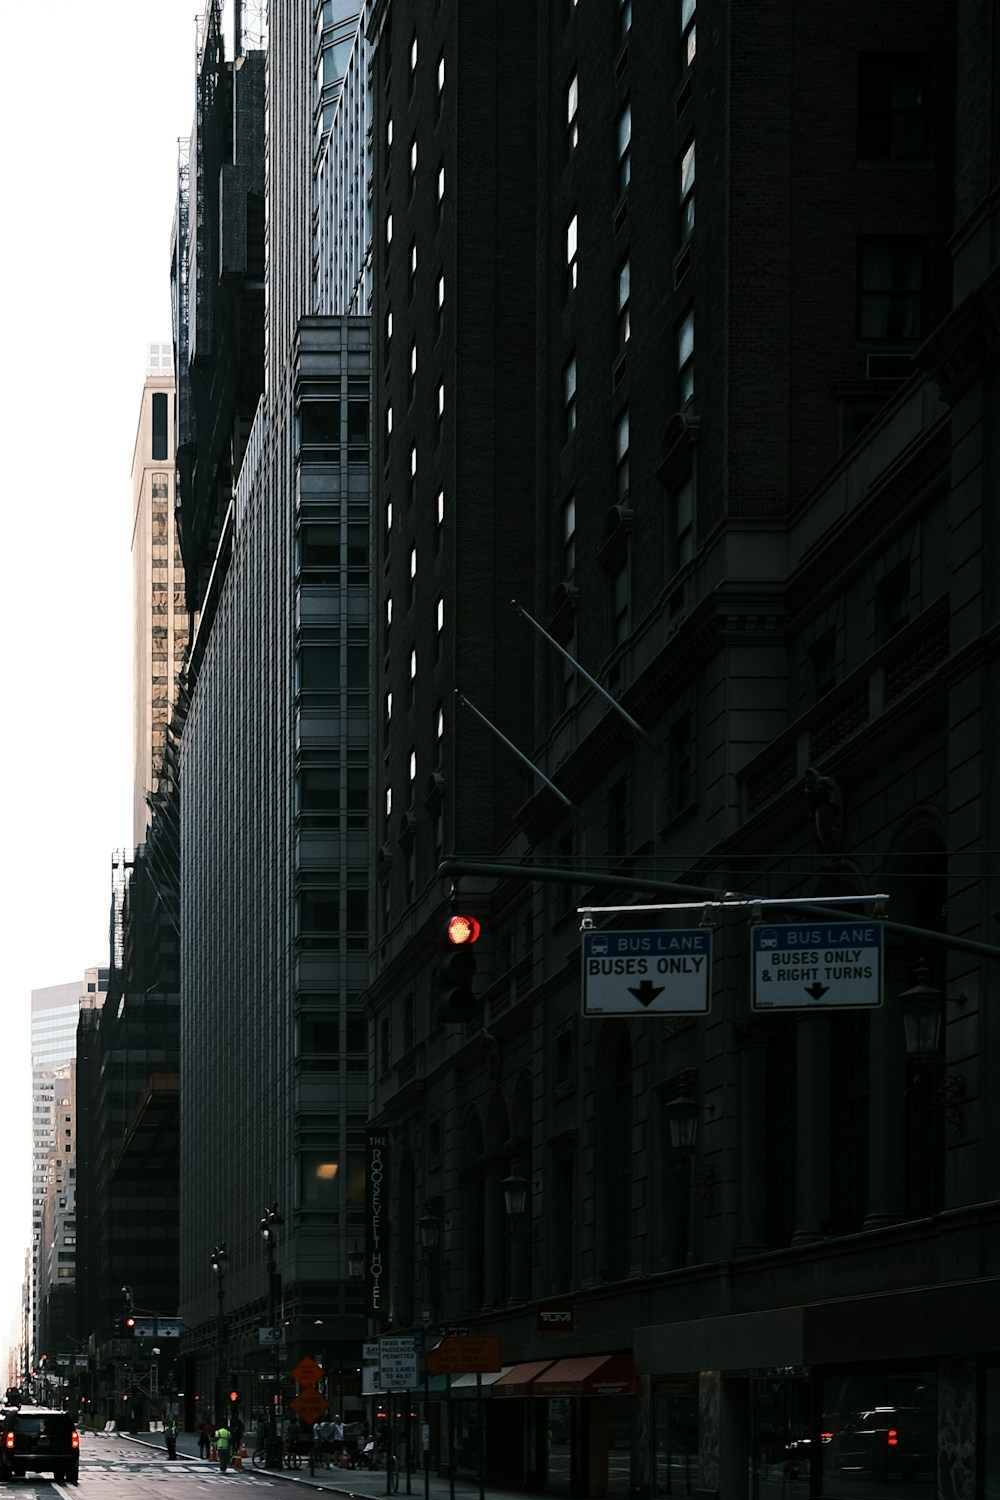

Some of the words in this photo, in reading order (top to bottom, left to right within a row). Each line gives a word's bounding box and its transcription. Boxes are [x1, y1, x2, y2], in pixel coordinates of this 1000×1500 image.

[617, 937, 651, 951] BUS
[657, 936, 704, 950] LANE
[787, 931, 821, 944] BUS
[828, 929, 875, 943] LANE
[771, 952, 819, 965] BUSES
[824, 950, 862, 963] ONLY
[589, 958, 648, 975] BUSES
[657, 957, 704, 973] ONLY
[762, 970, 772, 982] &
[777, 968, 819, 981] RIGHT
[825, 966, 873, 980] TURNS
[369, 1137, 387, 1145] THE
[370, 1149, 383, 1249] ROOSEVELT
[370, 1253, 383, 1309] HOTEL
[540, 1311, 571, 1322] TUMI
